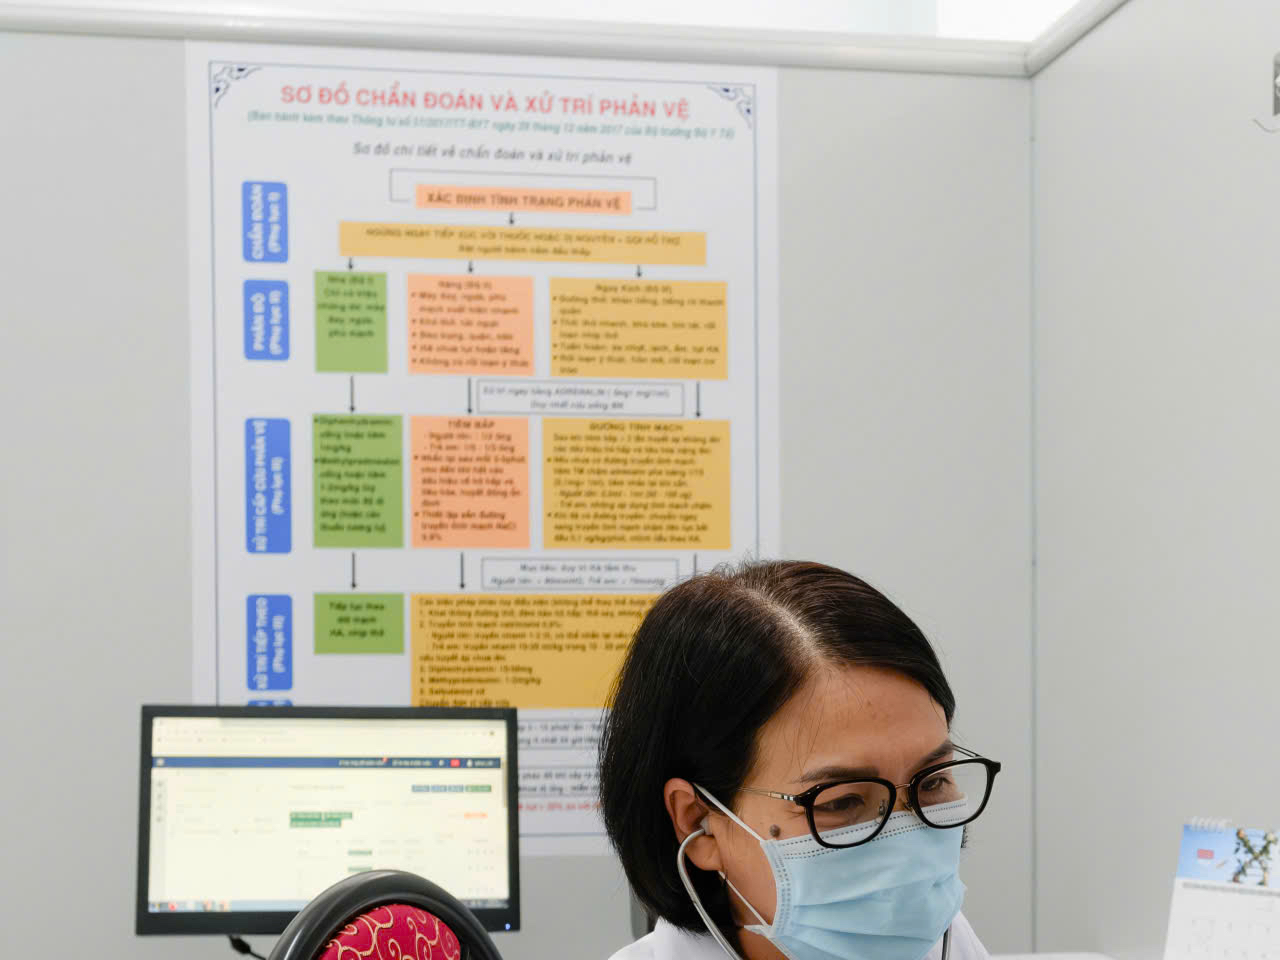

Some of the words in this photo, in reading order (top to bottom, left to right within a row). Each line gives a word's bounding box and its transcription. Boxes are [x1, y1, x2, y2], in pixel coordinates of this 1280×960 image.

[280, 85, 313, 105] SƠ
[319, 82, 348, 106] ĐỒ
[355, 82, 416, 108] CHẨN
[423, 92, 484, 111] ĐOÁN
[492, 96, 519, 112] VÀ
[525, 91, 551, 114] XỬ
[560, 97, 591, 115] TRÍ
[600, 95, 656, 117] PHẢN
[662, 98, 690, 122] VỆ
